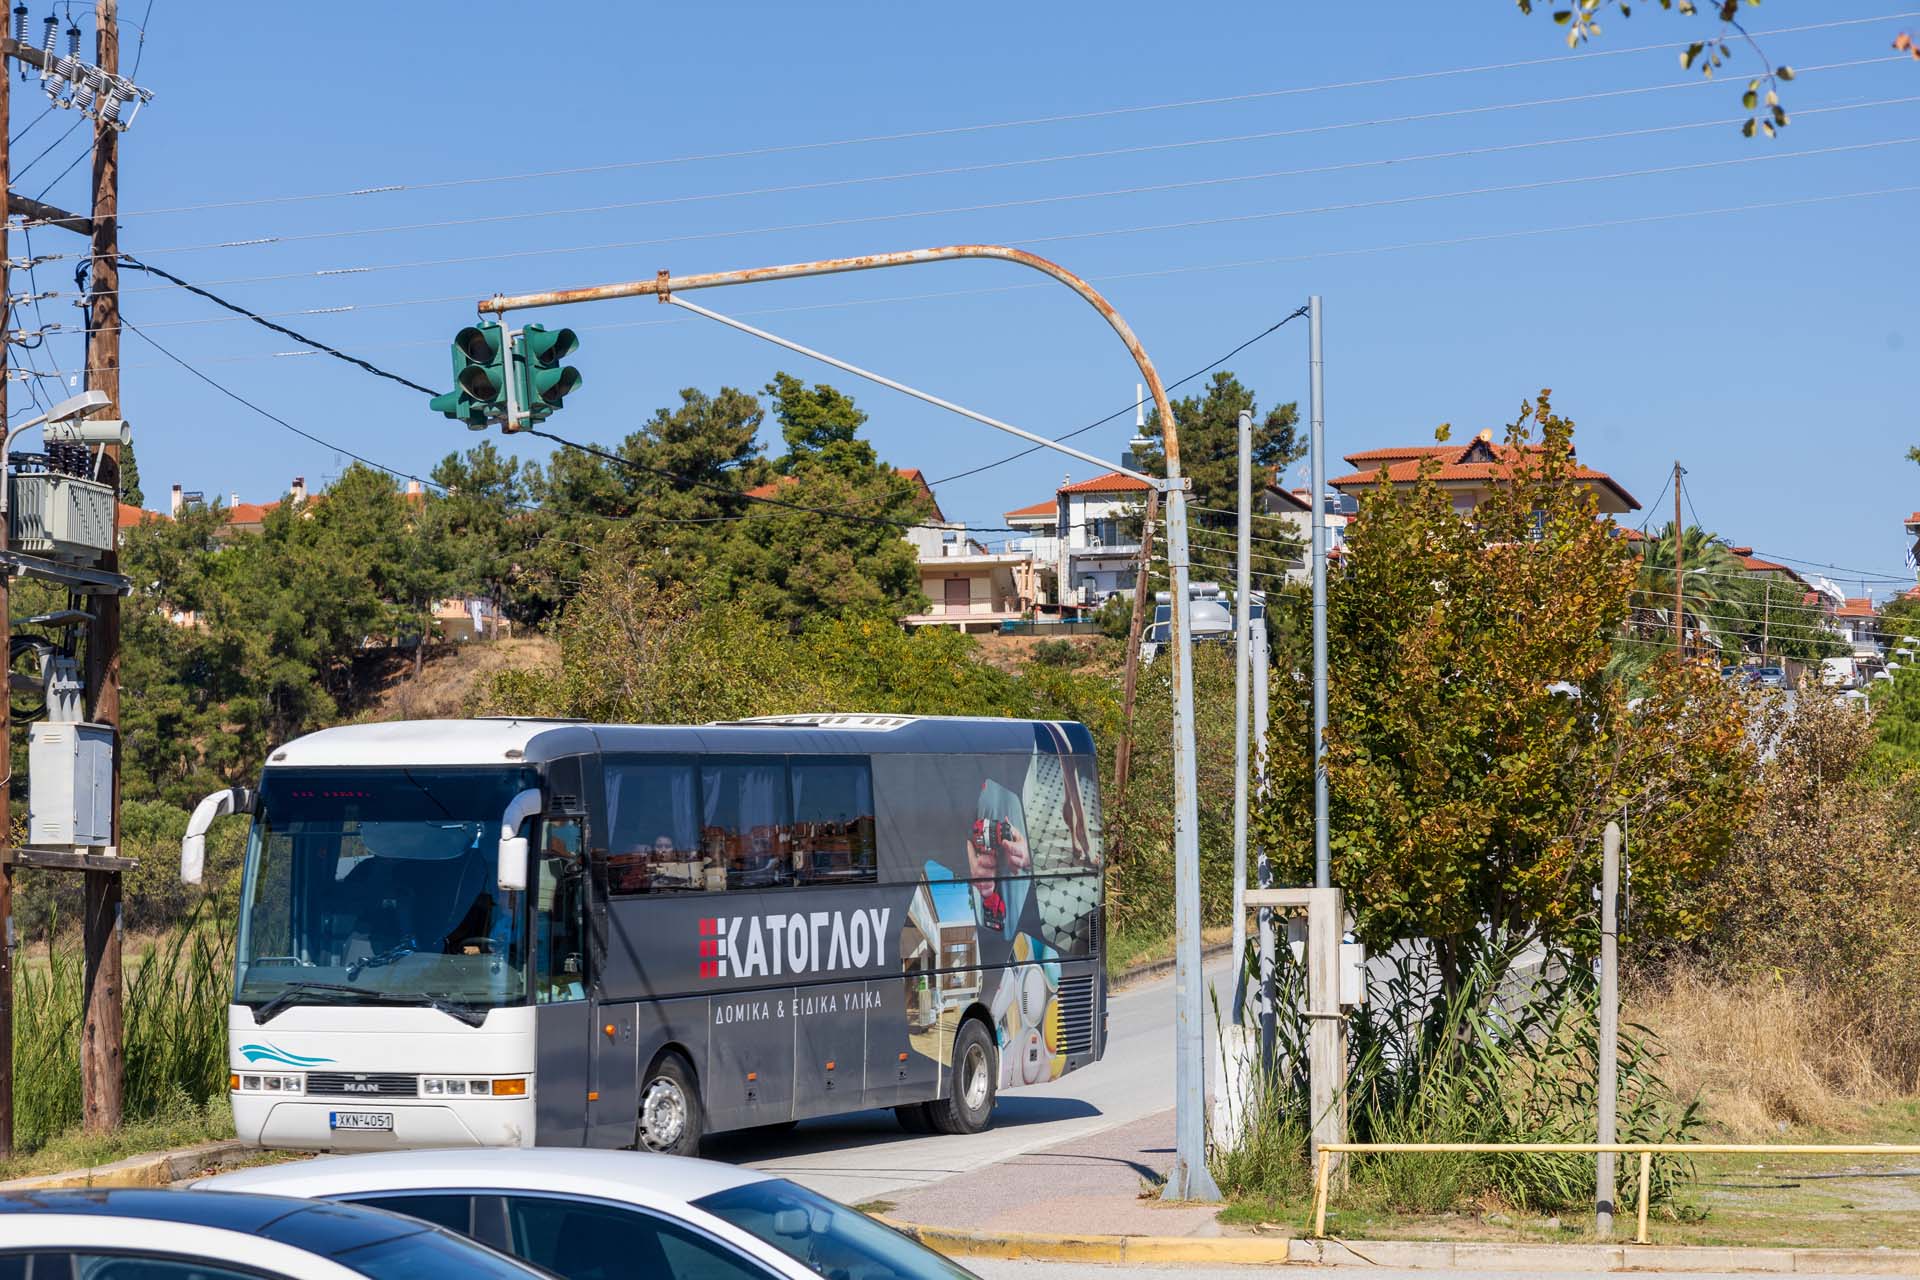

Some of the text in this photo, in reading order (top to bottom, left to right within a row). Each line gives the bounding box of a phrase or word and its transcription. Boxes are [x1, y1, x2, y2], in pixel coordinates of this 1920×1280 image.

[717, 908, 890, 978] ΚΑΤΟΓΛΟΥ
[715, 991, 882, 1025] ΔΟΜΙΚΑ & ΕΙΔΙΚΑ ΥΛΙΚΑ
[343, 1083, 379, 1092] MAN
